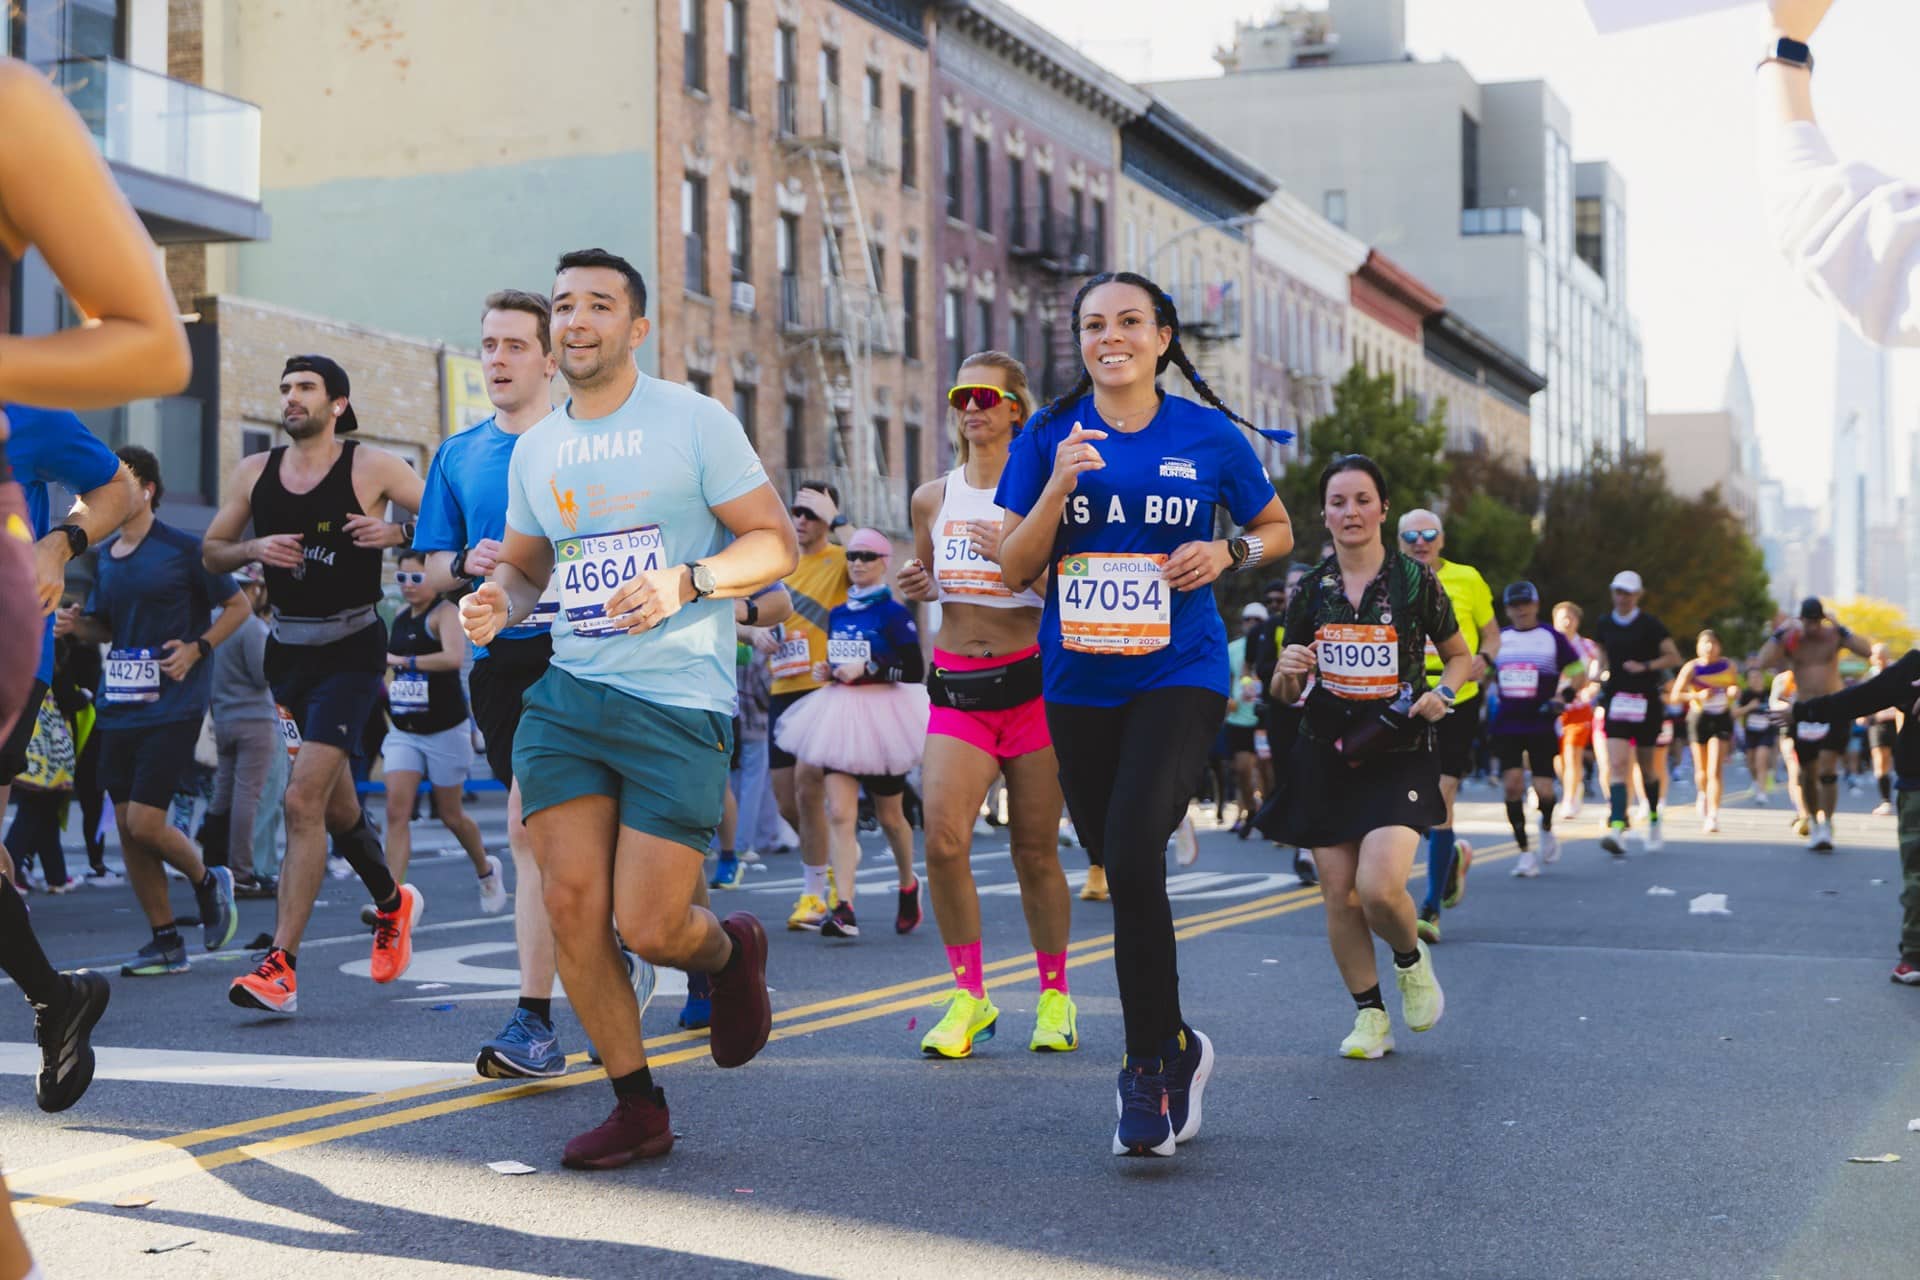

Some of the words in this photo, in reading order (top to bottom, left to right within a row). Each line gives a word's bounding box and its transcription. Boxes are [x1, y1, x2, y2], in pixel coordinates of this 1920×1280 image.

[557, 430, 643, 468] ITAMAR
[1107, 495, 1126, 524] A
[1145, 495, 1198, 527] BOY
[582, 539, 608, 555] It's
[613, 538, 624, 551] a
[628, 532, 660, 549] boy
[1065, 579, 1162, 611] 47054
[1322, 643, 1391, 668] 51903
[109, 661, 155, 680] 44275
